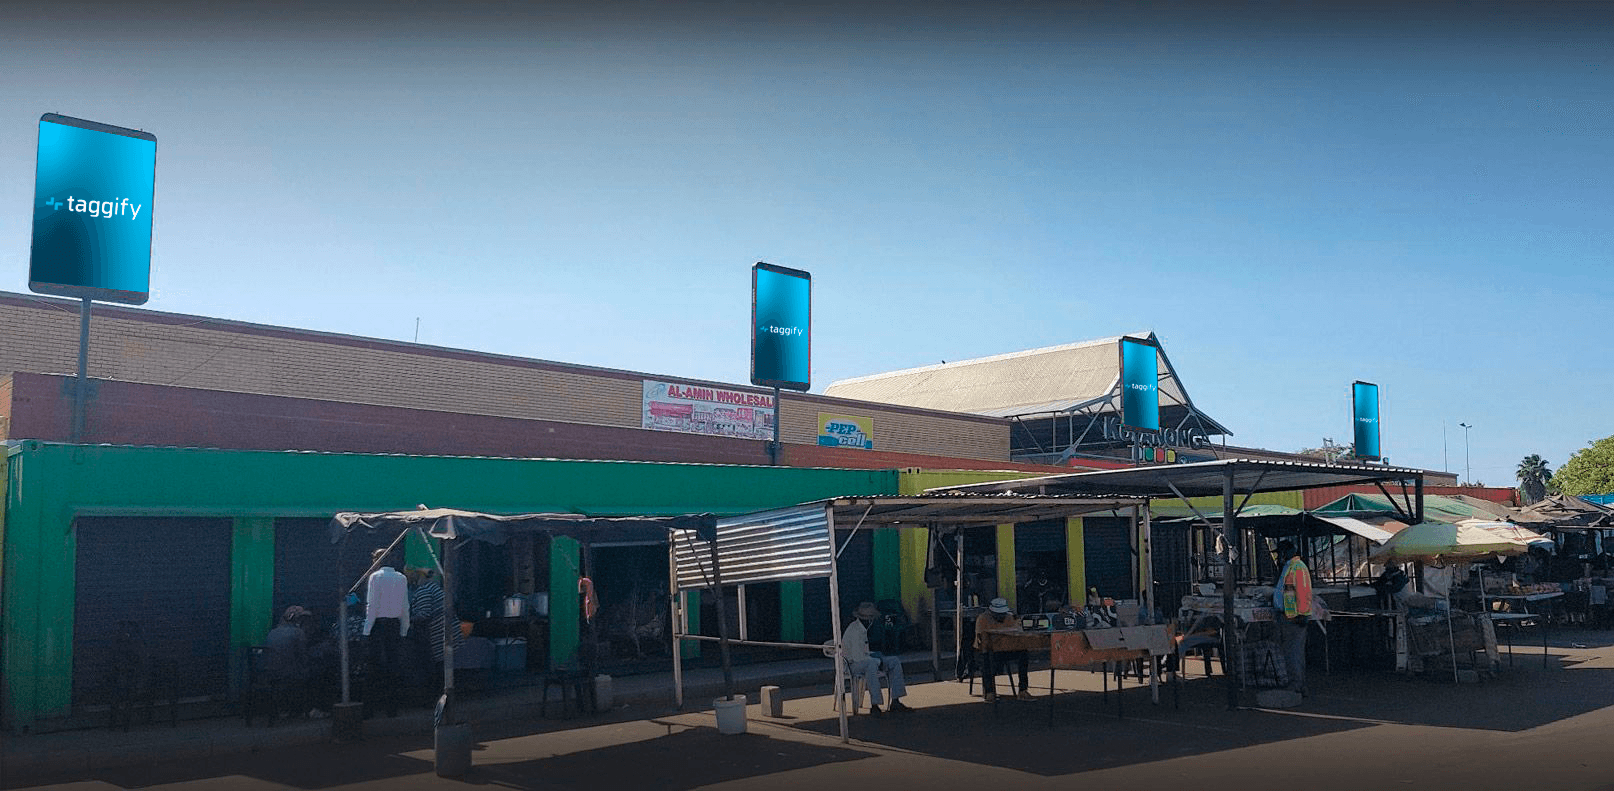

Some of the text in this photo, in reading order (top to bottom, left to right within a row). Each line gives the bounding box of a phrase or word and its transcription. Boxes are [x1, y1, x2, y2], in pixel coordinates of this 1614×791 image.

[67, 195, 142, 220] taggify
[770, 325, 803, 336] taggify
[668, 385, 775, 408] AL-AMIN WHOLESAL
